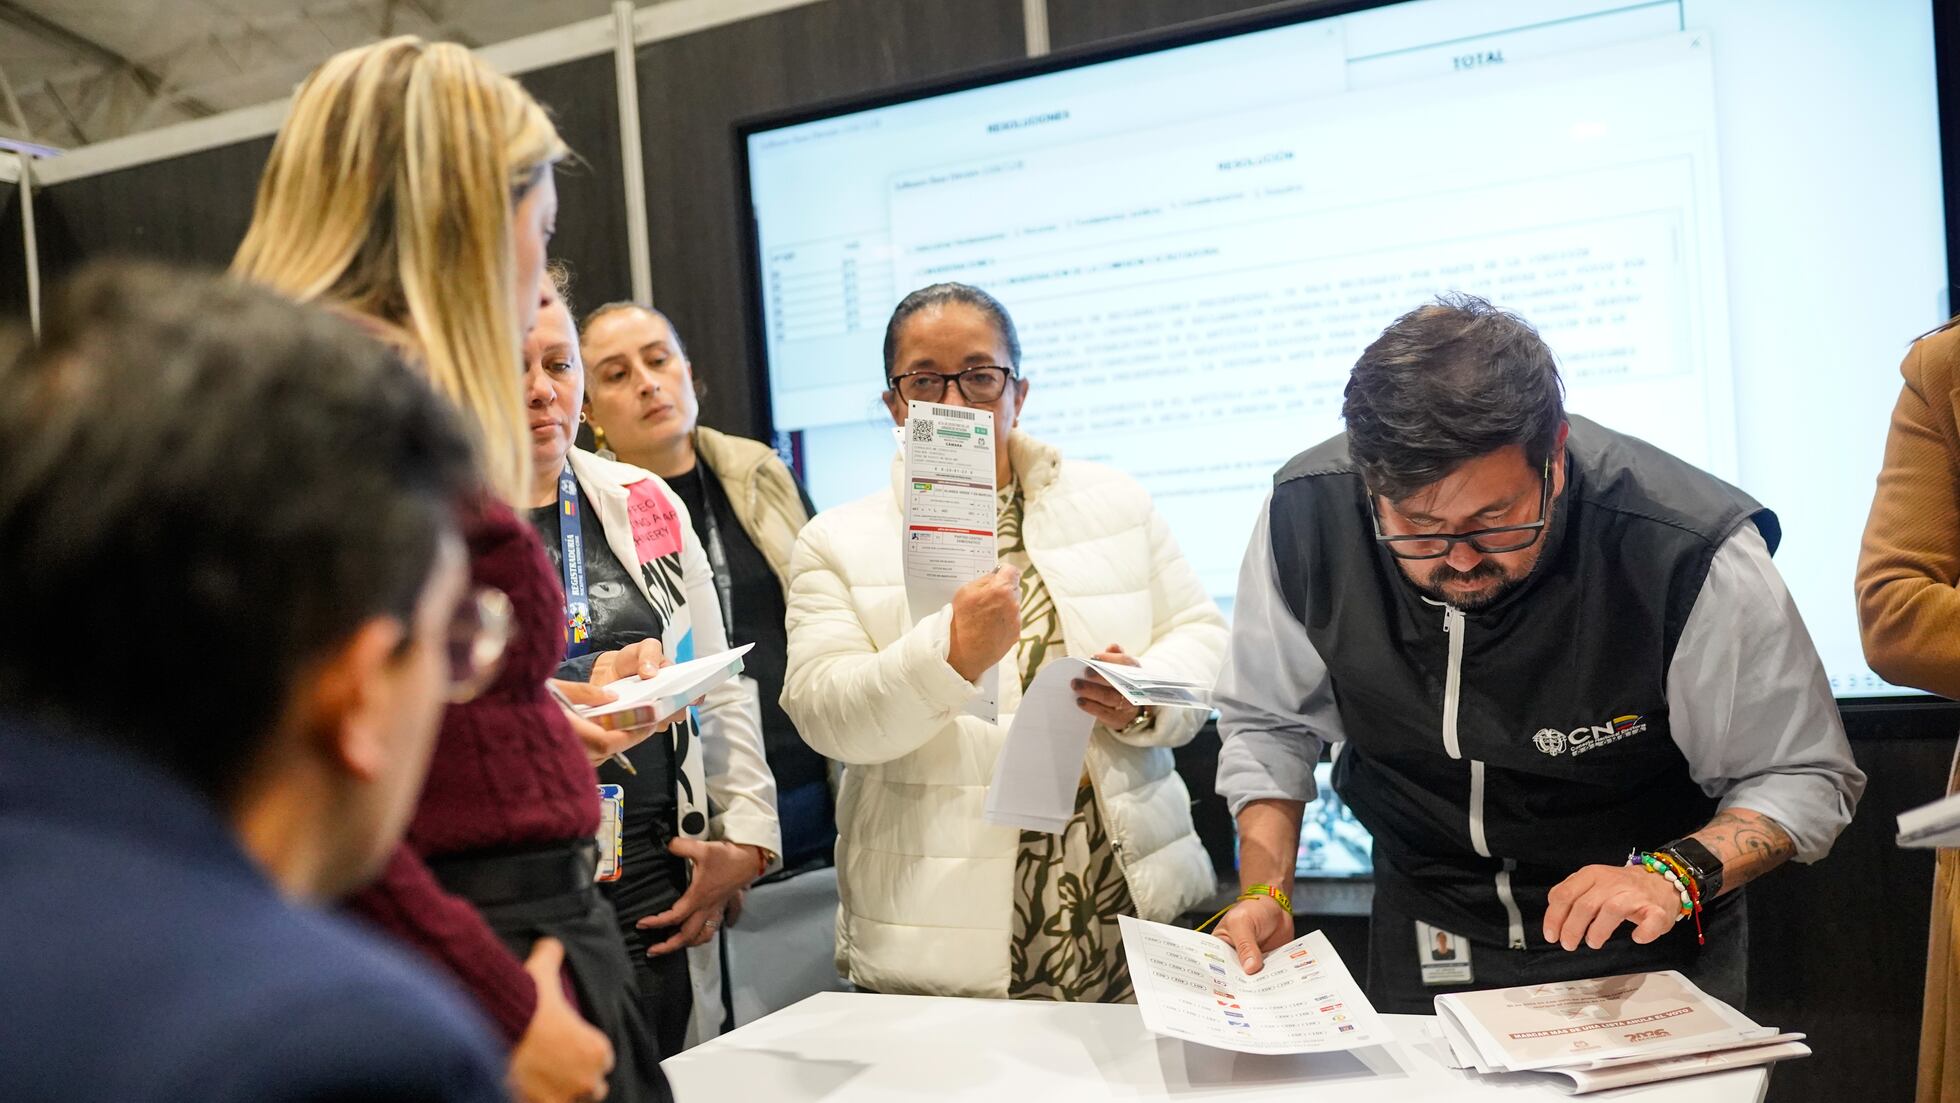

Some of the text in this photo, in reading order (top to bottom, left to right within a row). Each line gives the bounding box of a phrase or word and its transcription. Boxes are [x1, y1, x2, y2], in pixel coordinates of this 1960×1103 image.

[1453, 49, 1505, 69] TOTAL
[1513, 1031, 1550, 1039] MARCAR
[1582, 1023, 1600, 1031] UNA
[1601, 1020, 1625, 1029] LISTA
[1667, 1008, 1689, 1017] VOTO
